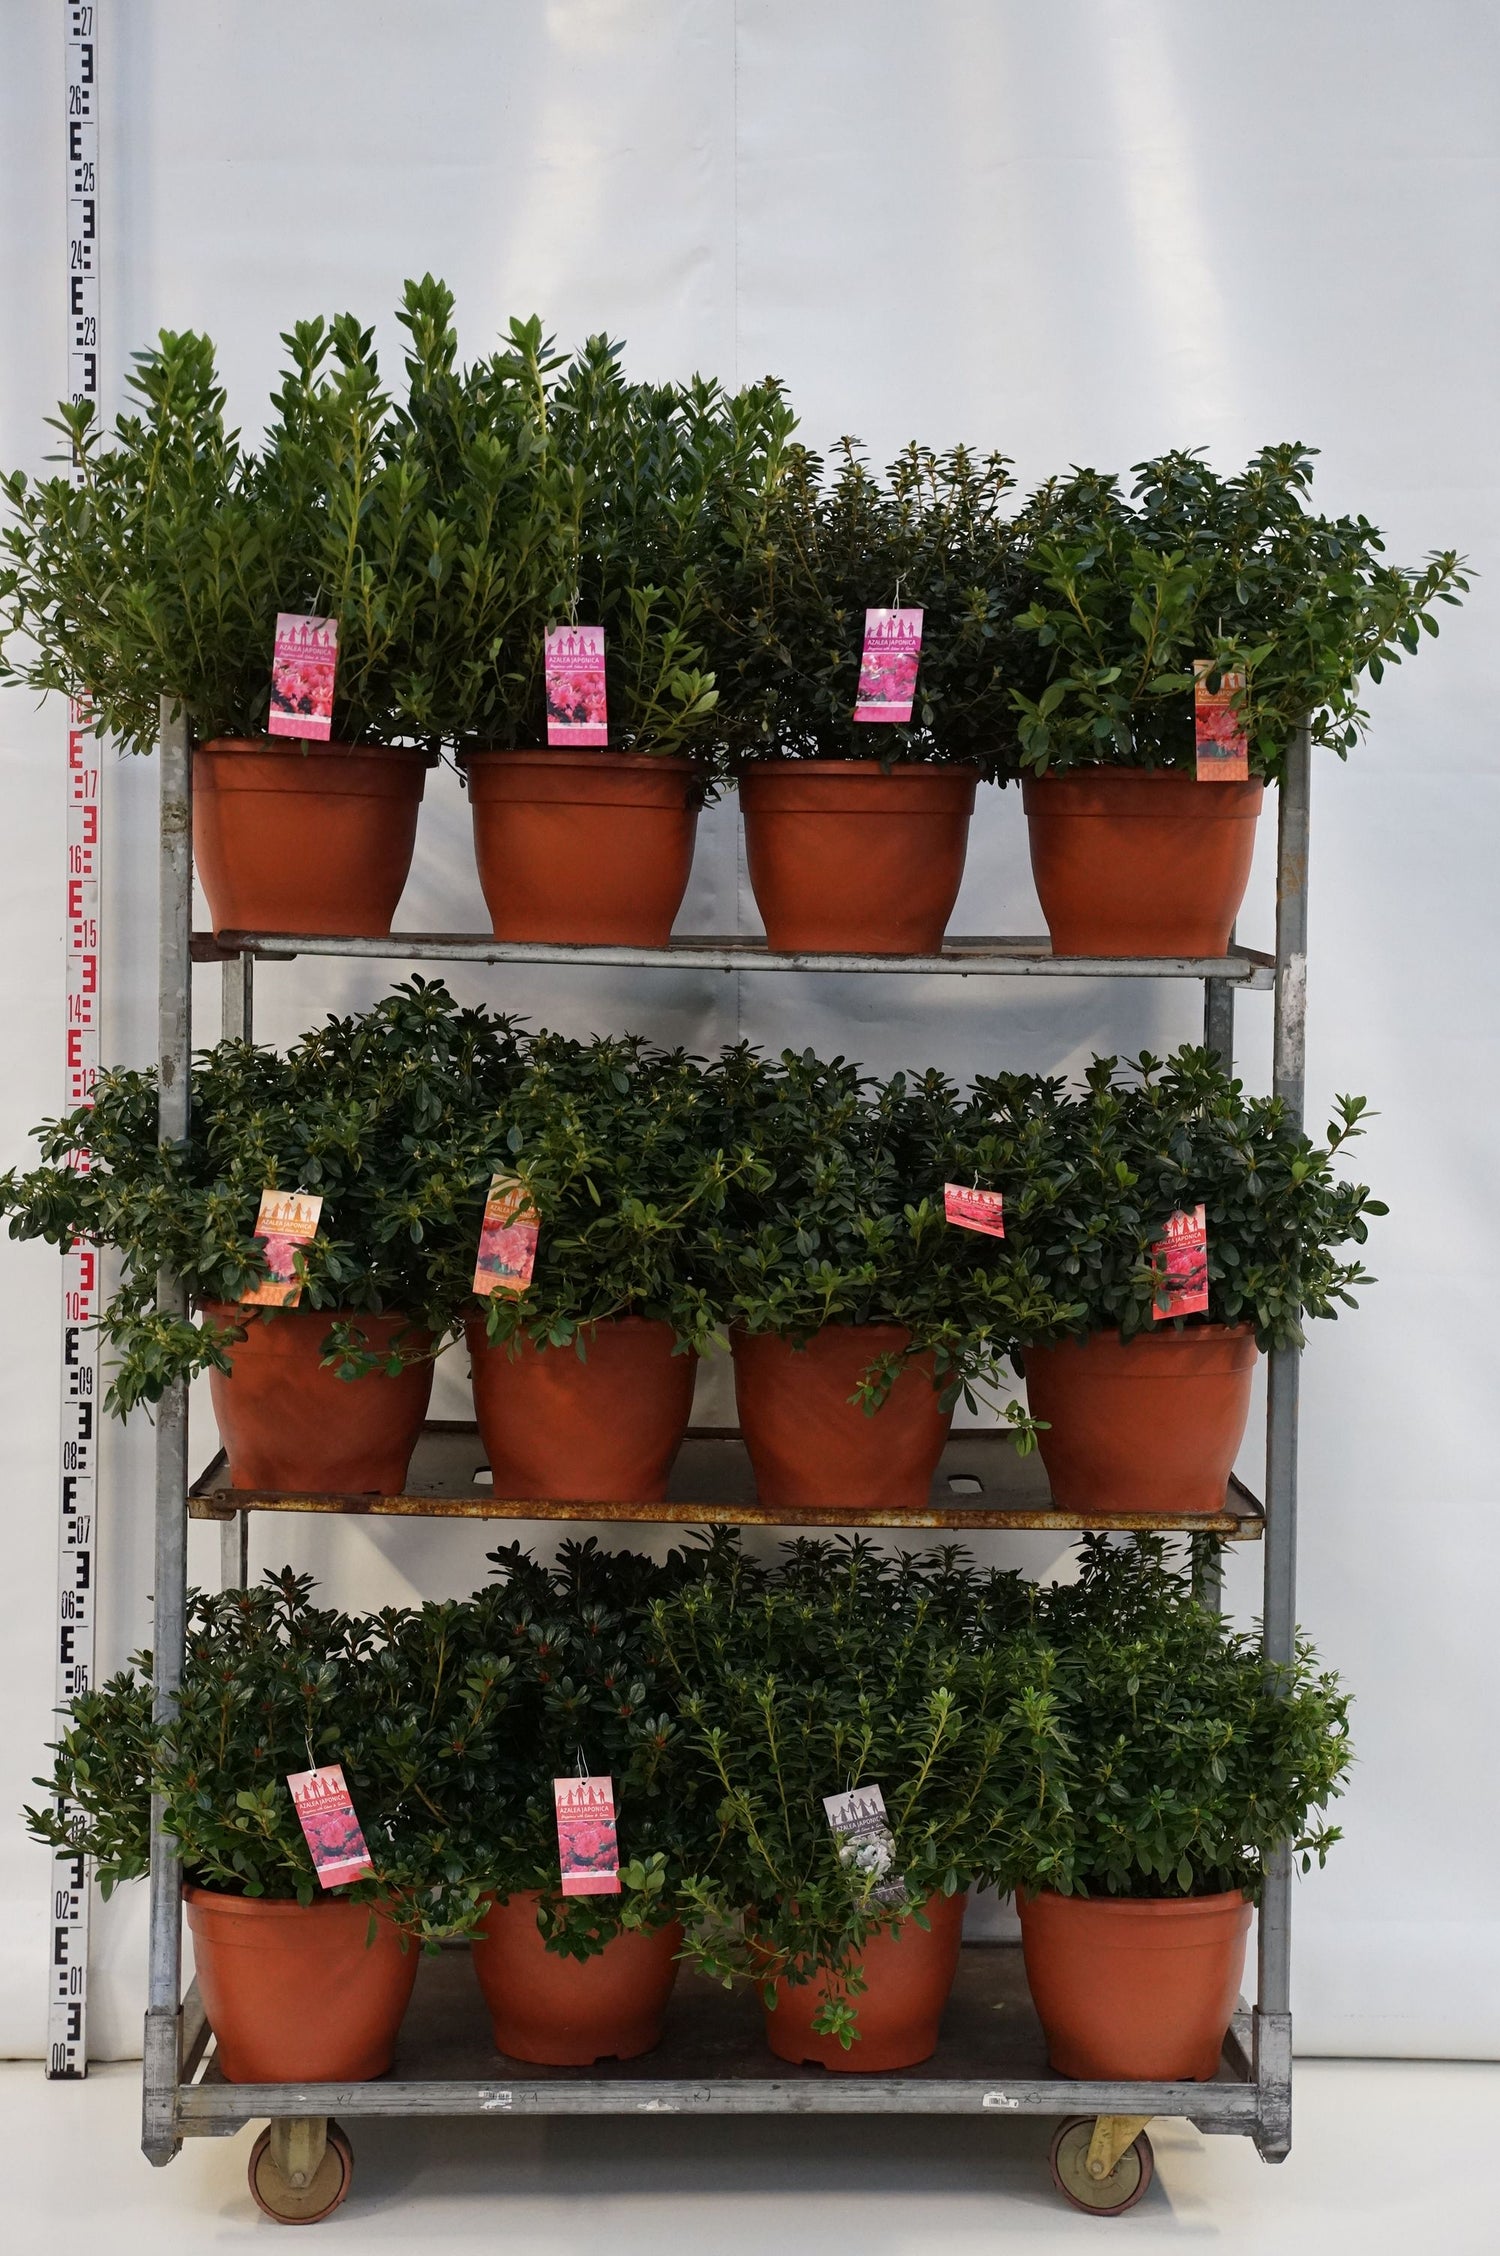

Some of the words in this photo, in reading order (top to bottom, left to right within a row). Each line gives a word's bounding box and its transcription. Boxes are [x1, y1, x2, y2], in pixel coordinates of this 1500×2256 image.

[81, 6, 93, 36] 27
[69, 85, 81, 115] 26
[83, 162, 95, 192] 25
[71, 240, 83, 269] 24
[84, 317, 96, 346] 23
[889, 639, 916, 648] JAPONICA
[571, 656, 600, 665] JAPONICA
[69, 695, 83, 724] 18
[84, 770, 97, 798] 17
[69, 845, 81, 873] 16
[83, 919, 97, 948] 15
[68, 994, 81, 1023] 14
[82, 1068, 96, 1097] 13
[1175, 1231, 1202, 1244] JAPONICA
[66, 1292, 79, 1320] 10
[79, 1366, 93, 1395] 09
[63, 1441, 77, 1470] 08
[76, 1515, 91, 1544] 07
[61, 1590, 75, 1619] 06
[74, 1665, 88, 1693] 05
[300, 1800, 319, 1809] AZALEA
[319, 1794, 345, 1808] JAPONICA
[581, 1806, 609, 1815] JAPONICA
[55, 1890, 70, 1919] 02
[70, 1966, 83, 1995] 01
[52, 2043, 66, 2072] 00
